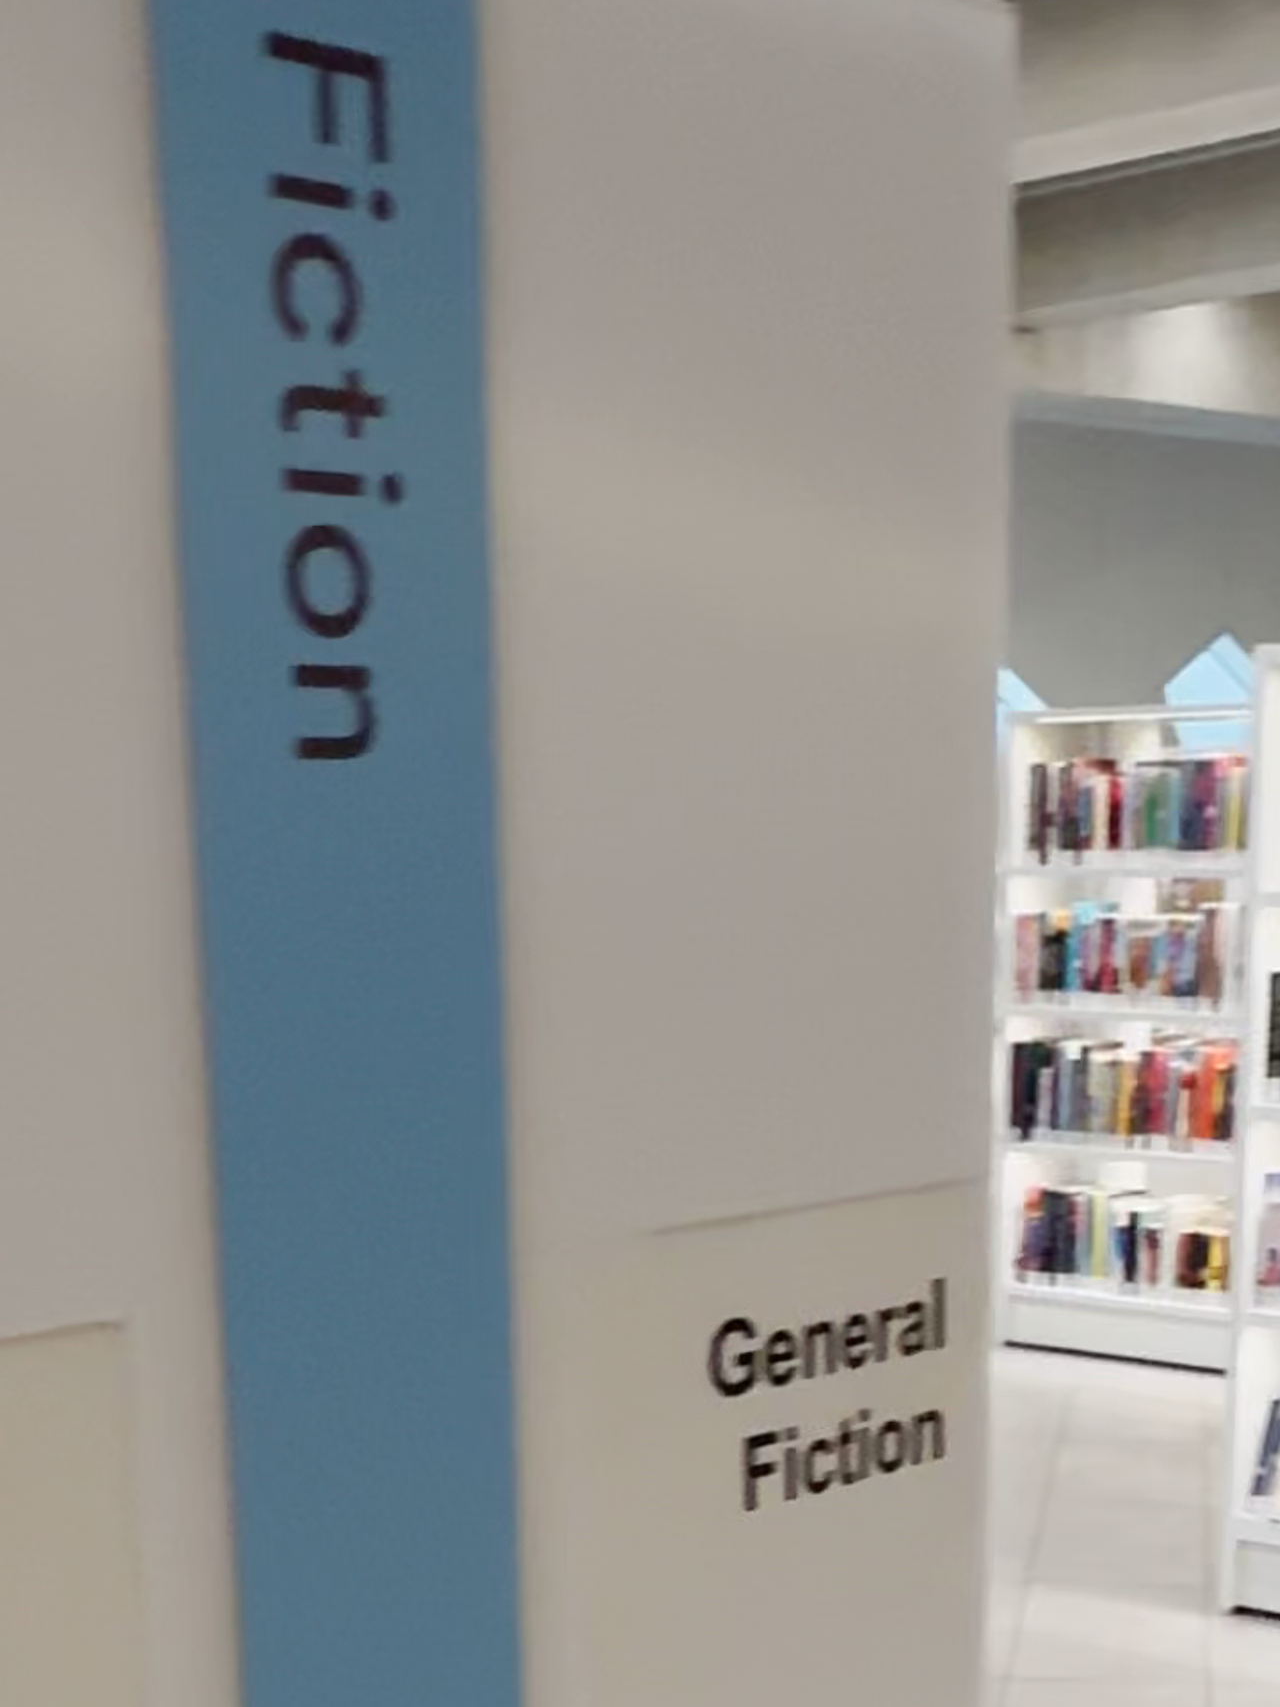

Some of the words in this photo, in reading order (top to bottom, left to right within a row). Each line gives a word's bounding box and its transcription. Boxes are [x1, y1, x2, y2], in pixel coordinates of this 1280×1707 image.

[261, 30, 404, 761] Fiction
[706, 1278, 947, 1397] General
[741, 1408, 946, 1512] Fiction
